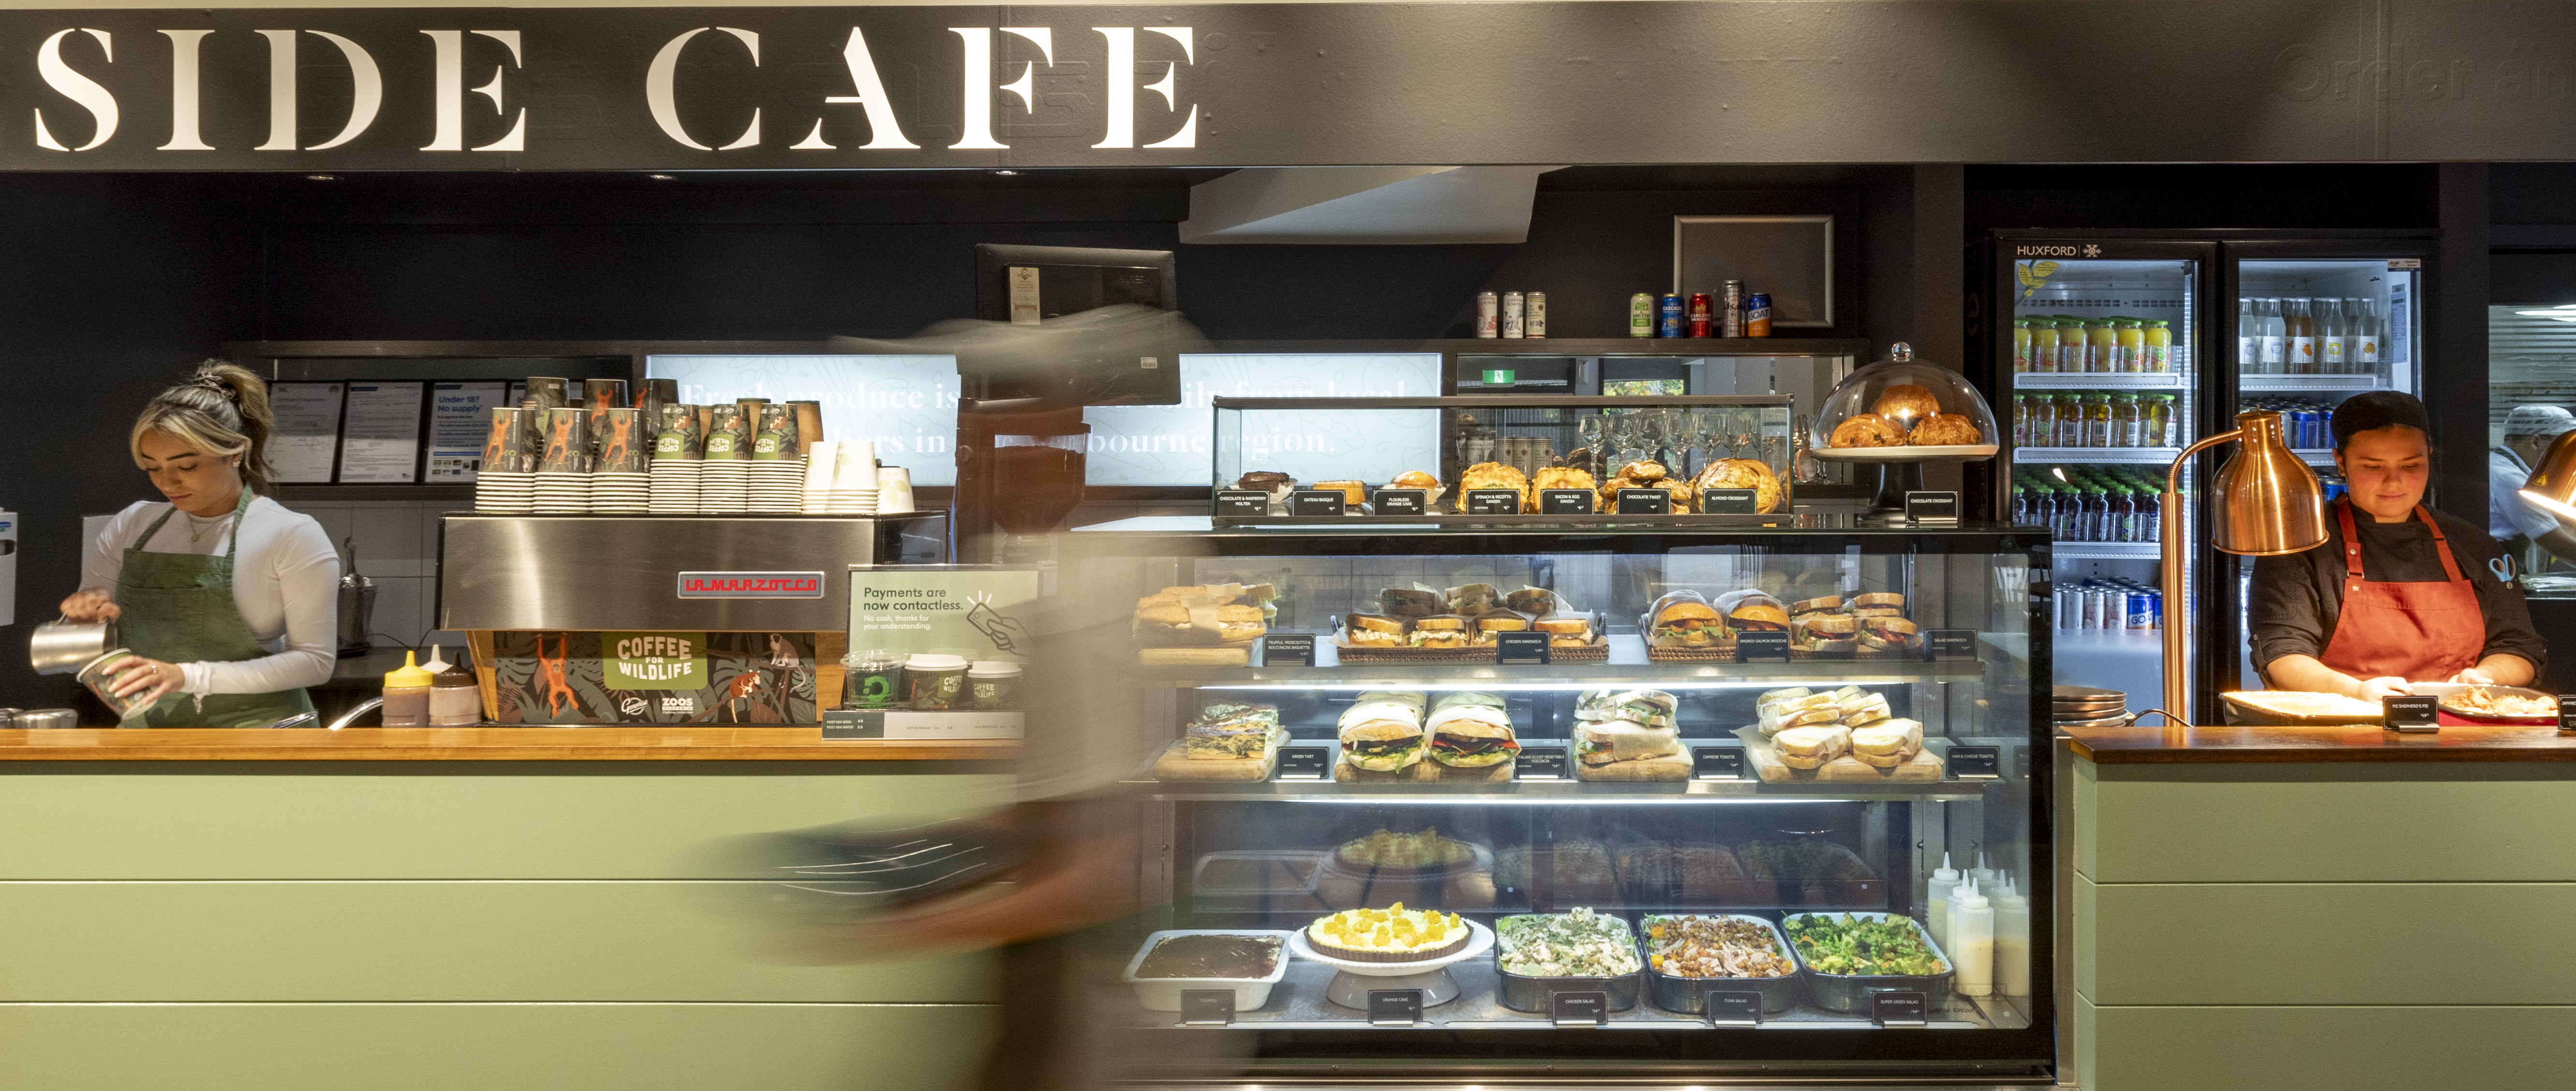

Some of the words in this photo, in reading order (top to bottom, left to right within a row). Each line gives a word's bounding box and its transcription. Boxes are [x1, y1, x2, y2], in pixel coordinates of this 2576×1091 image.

[35, 27, 527, 151] SIDE
[646, 26, 1198, 151] CAFE
[2017, 245, 2077, 256] HUXFORD
[1749, 309, 1768, 320] GOAT
[914, 427, 947, 453] in
[685, 579, 704, 591] LA
[710, 579, 817, 591] MARZOCCO
[864, 587, 922, 600] Payments
[926, 589, 946, 597] are
[893, 599, 963, 610] contactless.
[881, 622, 932, 631] understanding.
[617, 636, 692, 660] COFFEE
[618, 662, 692, 680] WILDLIFE
[974, 683, 995, 691] COFFEE
[662, 698, 693, 706] ZOOS
